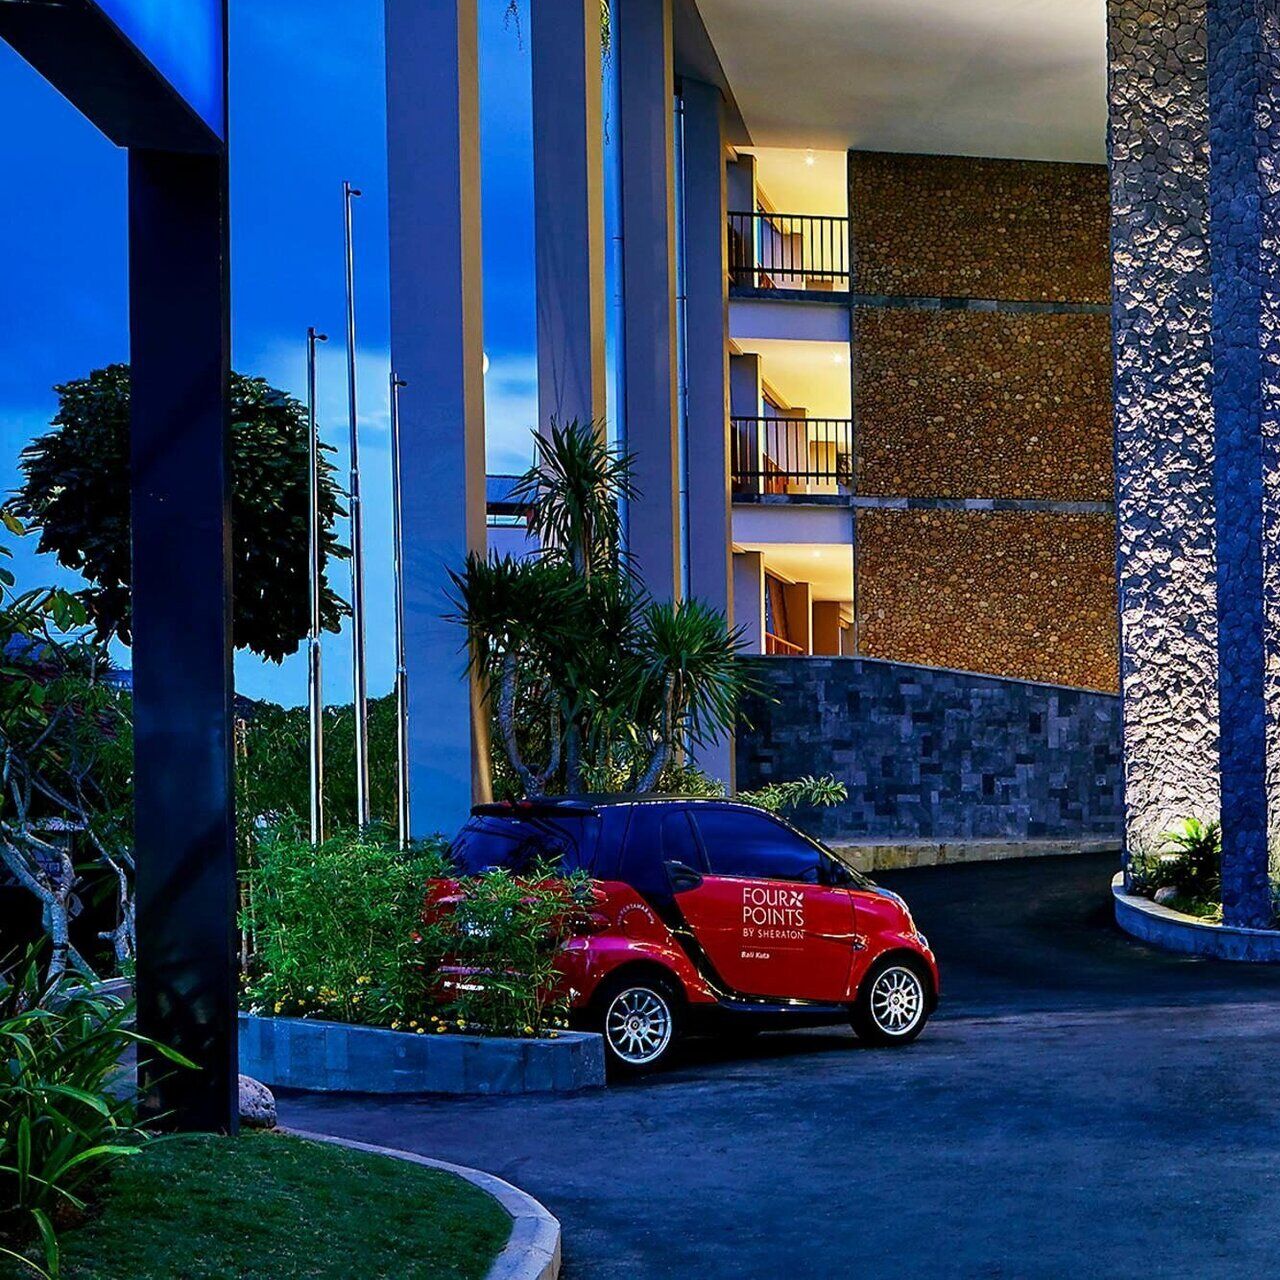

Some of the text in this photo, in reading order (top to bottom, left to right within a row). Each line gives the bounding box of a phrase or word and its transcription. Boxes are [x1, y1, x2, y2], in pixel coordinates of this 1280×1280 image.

[743, 887, 790, 907] FOUR
[743, 906, 805, 927] POINTS
[743, 927, 805, 940] BY SHERATON
